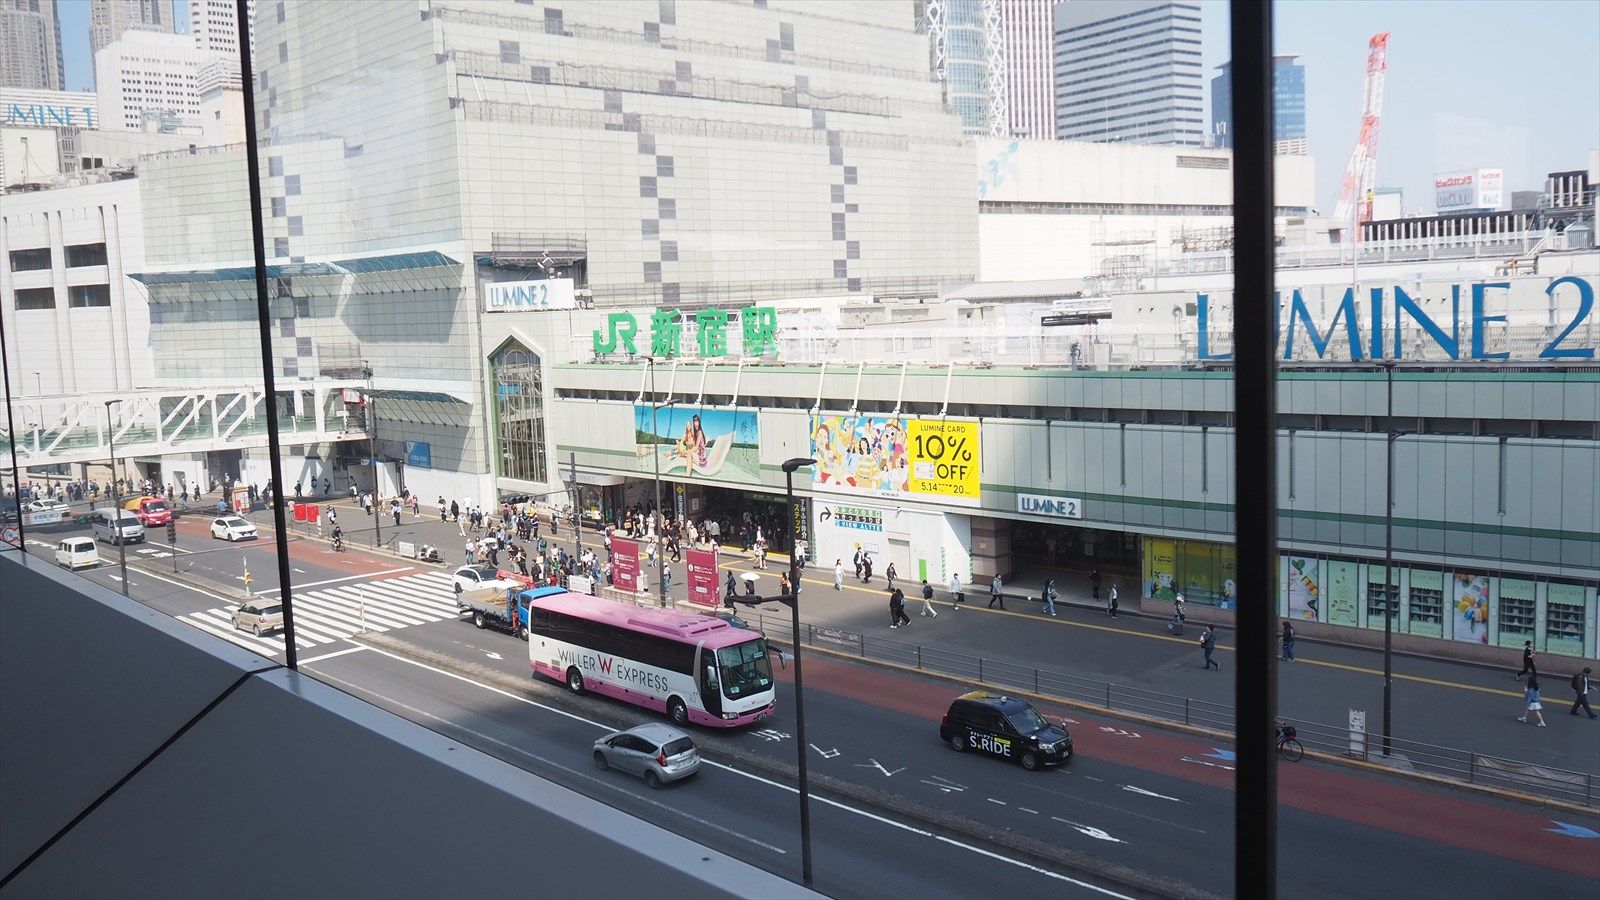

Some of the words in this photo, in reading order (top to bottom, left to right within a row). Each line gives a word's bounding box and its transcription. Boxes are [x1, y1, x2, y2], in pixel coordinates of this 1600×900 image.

[83, 106, 93, 127] 1
[490, 285, 537, 307] LUMINE
[540, 284, 549, 305] 2
[1197, 284, 1511, 362] LMINE
[1539, 276, 1595, 359] 2
[920, 424, 945, 433] LUMINE
[946, 425, 966, 434] CARD
[915, 434, 972, 462] 10%
[936, 463, 968, 480] OFF
[1021, 497, 1066, 515] LUMINE
[1068, 501, 1076, 516] 2
[558, 648, 596, 672] WILLER
[597, 654, 613, 675] W
[617, 664, 669, 692] EXPRESS
[969, 735, 1011, 758] S.RIDE
